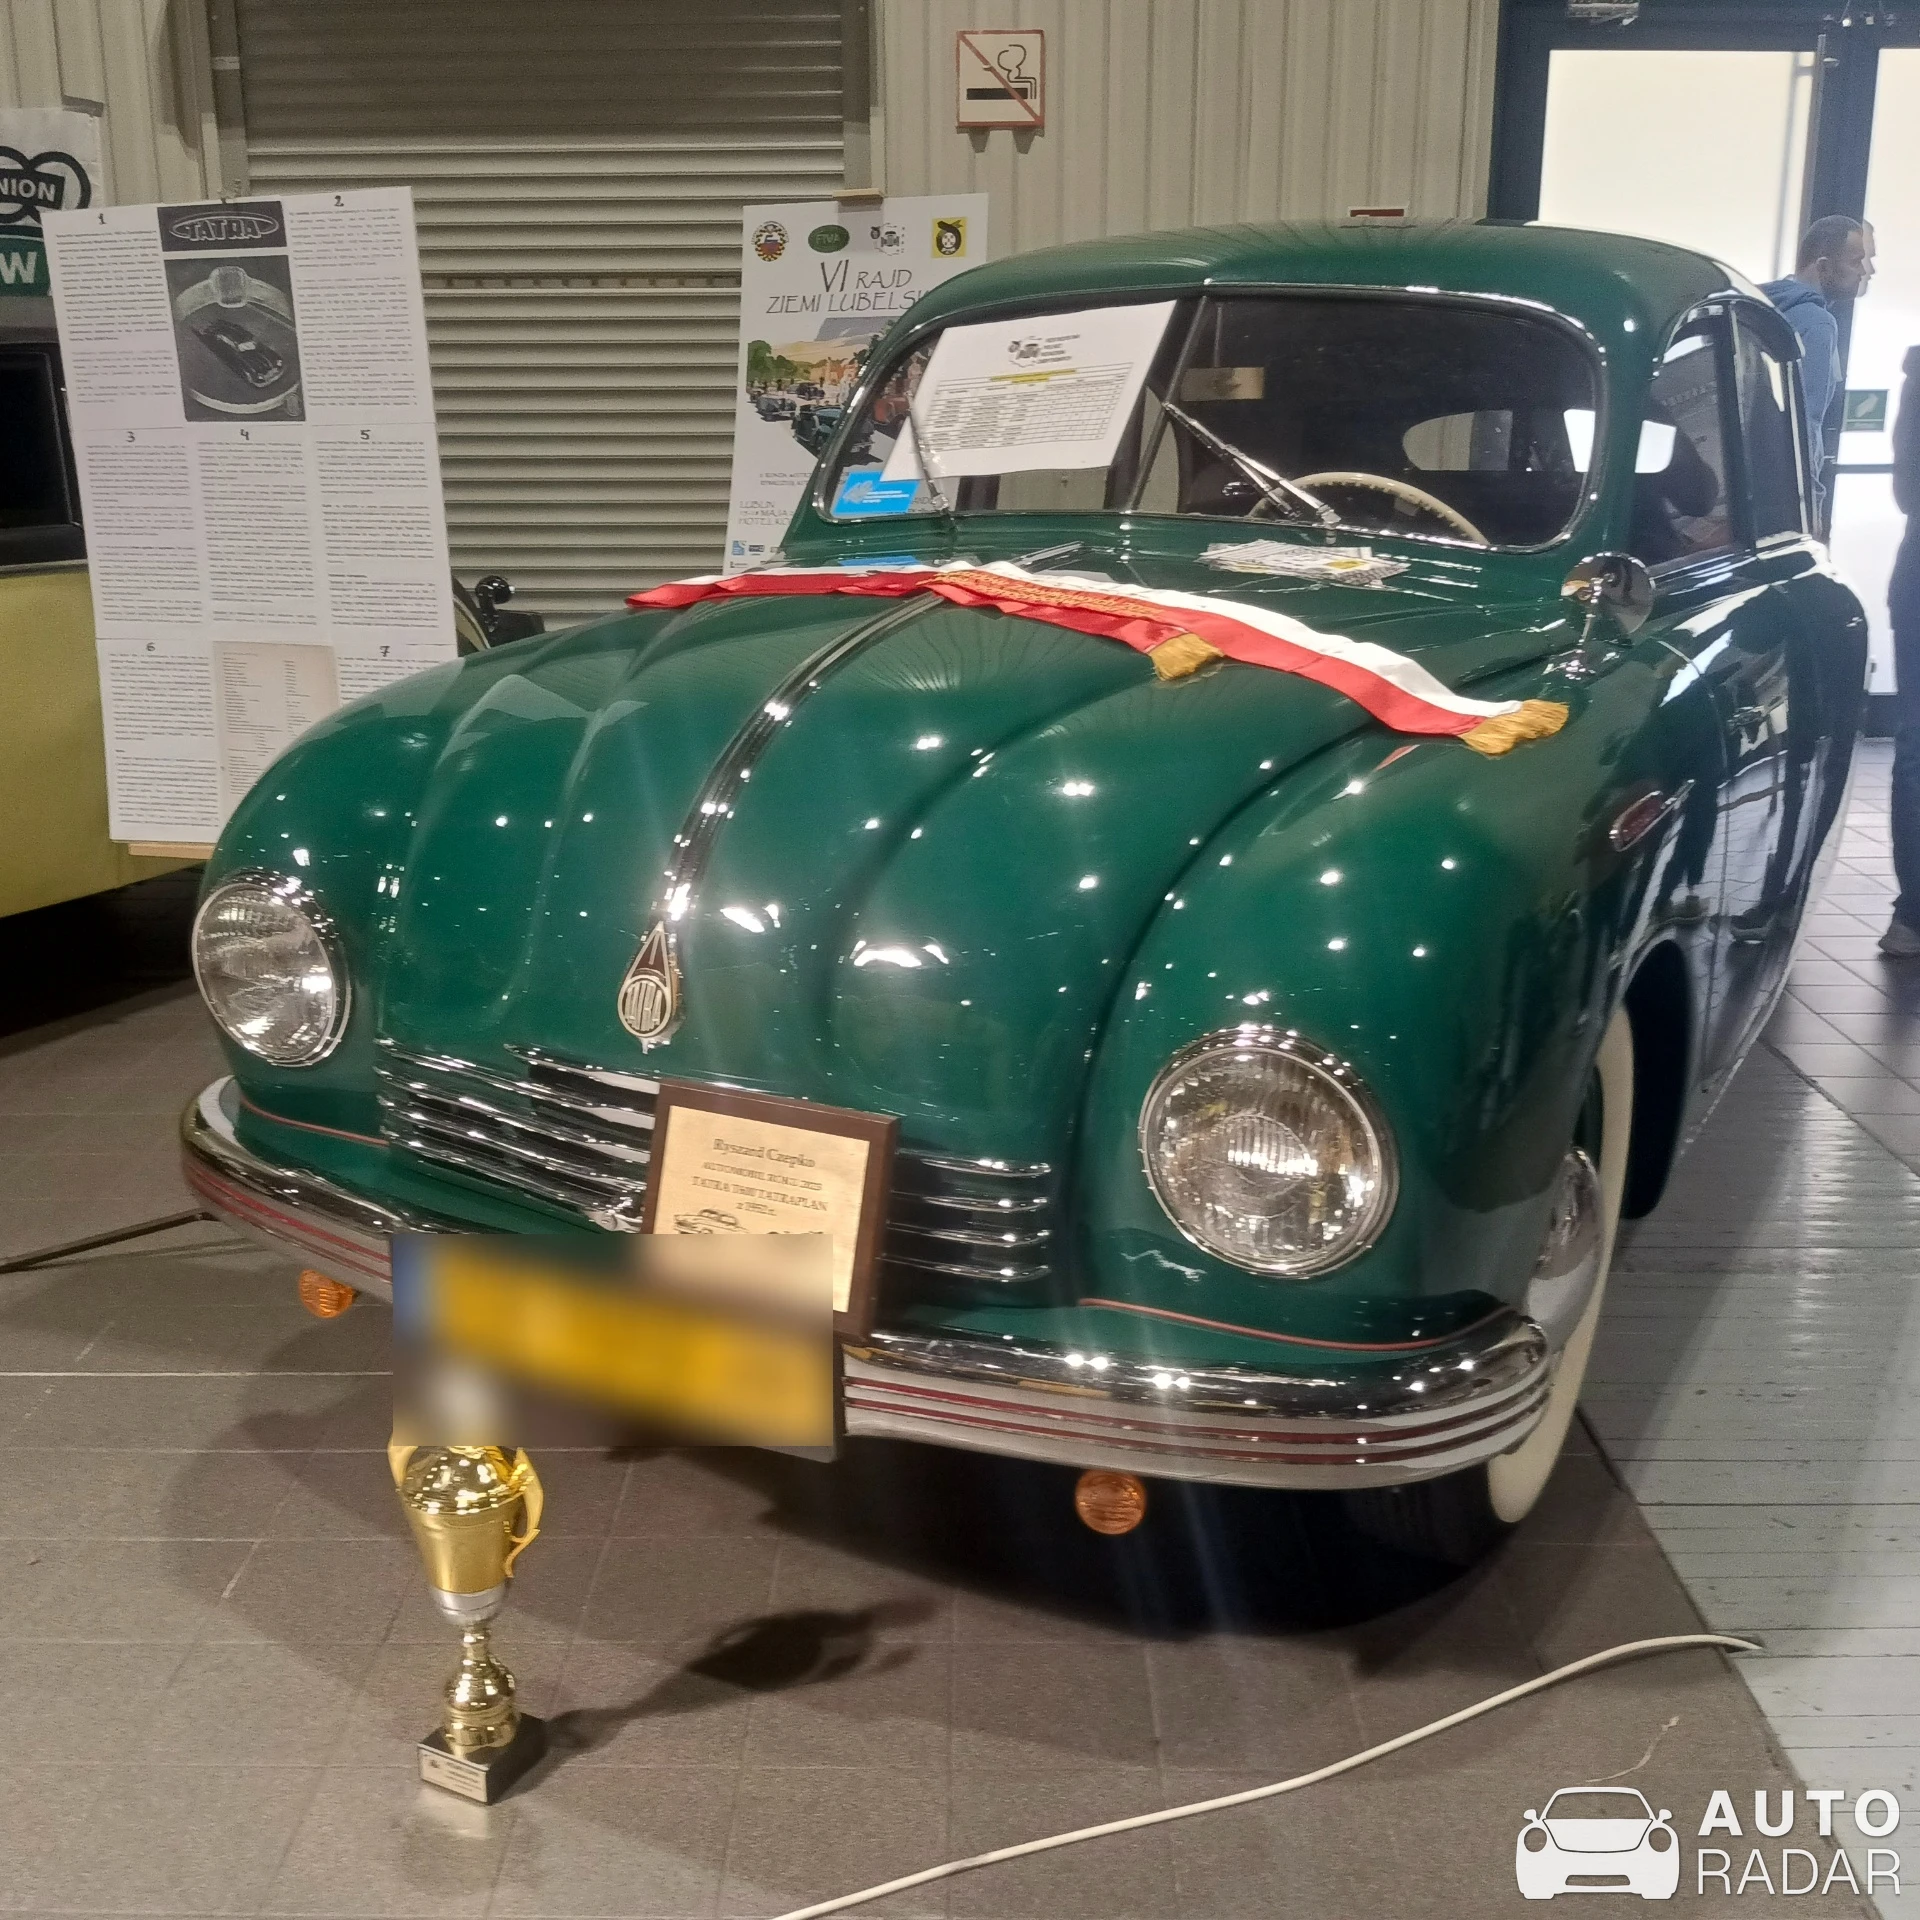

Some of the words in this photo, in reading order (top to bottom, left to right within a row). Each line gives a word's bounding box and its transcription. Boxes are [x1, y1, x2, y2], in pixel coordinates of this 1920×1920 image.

[333, 195, 345, 207] 2
[98, 213, 107, 225] 1
[185, 219, 262, 242] TATRA
[820, 259, 849, 292] VI
[855, 269, 912, 289] RAJD
[766, 294, 822, 314] ZIEMI
[125, 431, 136, 443] 3
[240, 429, 250, 441] 4
[360, 429, 370, 441] 5
[146, 642, 156, 653] 6
[379, 646, 391, 658] 7
[713, 1138, 765, 1158] Ryszard
[766, 1148, 816, 1168] Czepko
